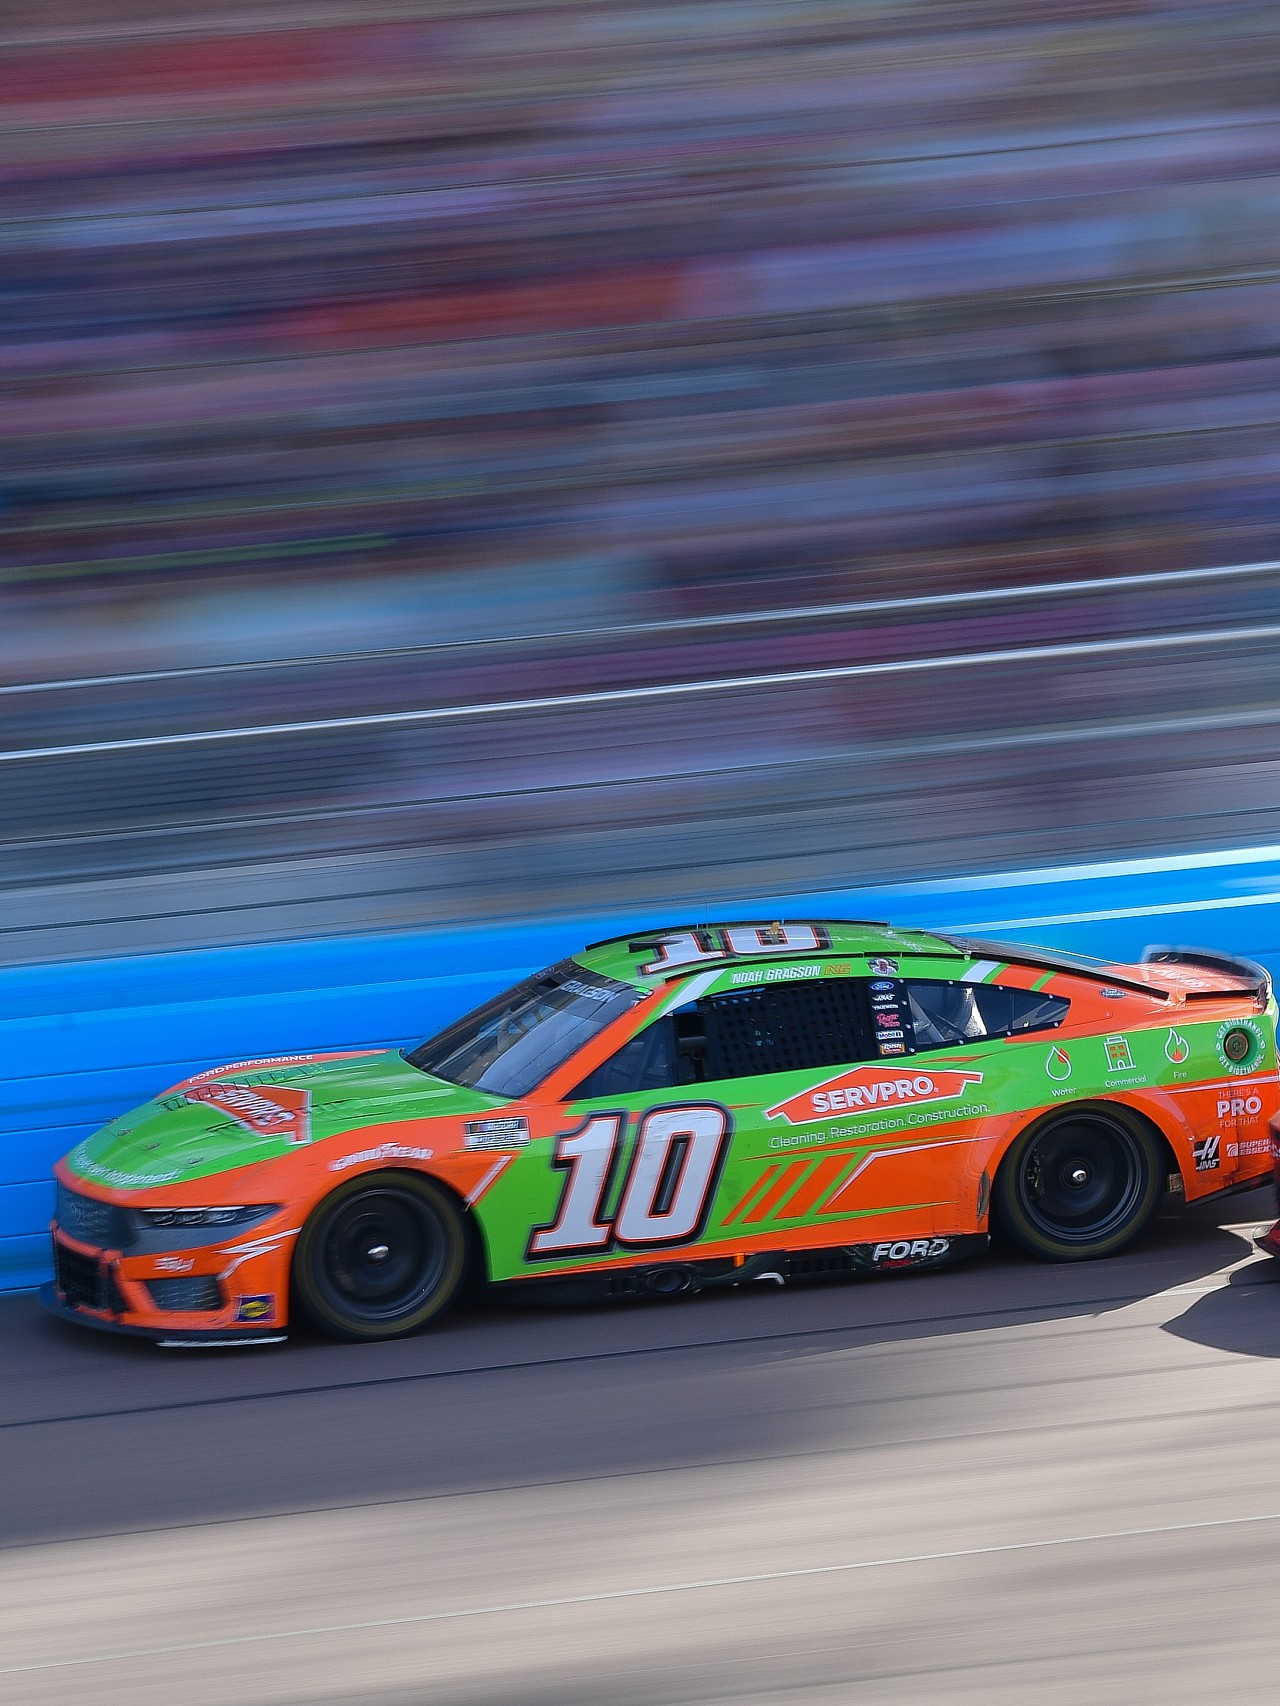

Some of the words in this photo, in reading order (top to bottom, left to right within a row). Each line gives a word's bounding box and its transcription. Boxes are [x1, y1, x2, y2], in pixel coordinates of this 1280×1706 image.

[640, 925, 832, 977] 10
[731, 970, 763, 985] NOAH
[766, 965, 821, 982] GRAGSON
[188, 1065, 225, 1084] FORD
[225, 1054, 314, 1071] PERFORMANCE
[1173, 1071, 1188, 1079] Fire
[1051, 1087, 1077, 1097] Water
[1105, 1074, 1148, 1088] Commercial
[811, 1076, 934, 1113] SERVPRO
[1218, 1087, 1252, 1099] THERE'S
[1252, 1087, 1259, 1095] A
[1217, 1096, 1262, 1118] PRO
[769, 1132, 828, 1149] Cleaning.
[830, 1117, 907, 1138] Restoration.
[908, 1103, 991, 1125] Construction.
[1220, 1119, 1237, 1129] FOR
[1239, 1116, 1259, 1126] THAT
[525, 1100, 734, 1263] 10
[873, 1239, 949, 1261] FORD
